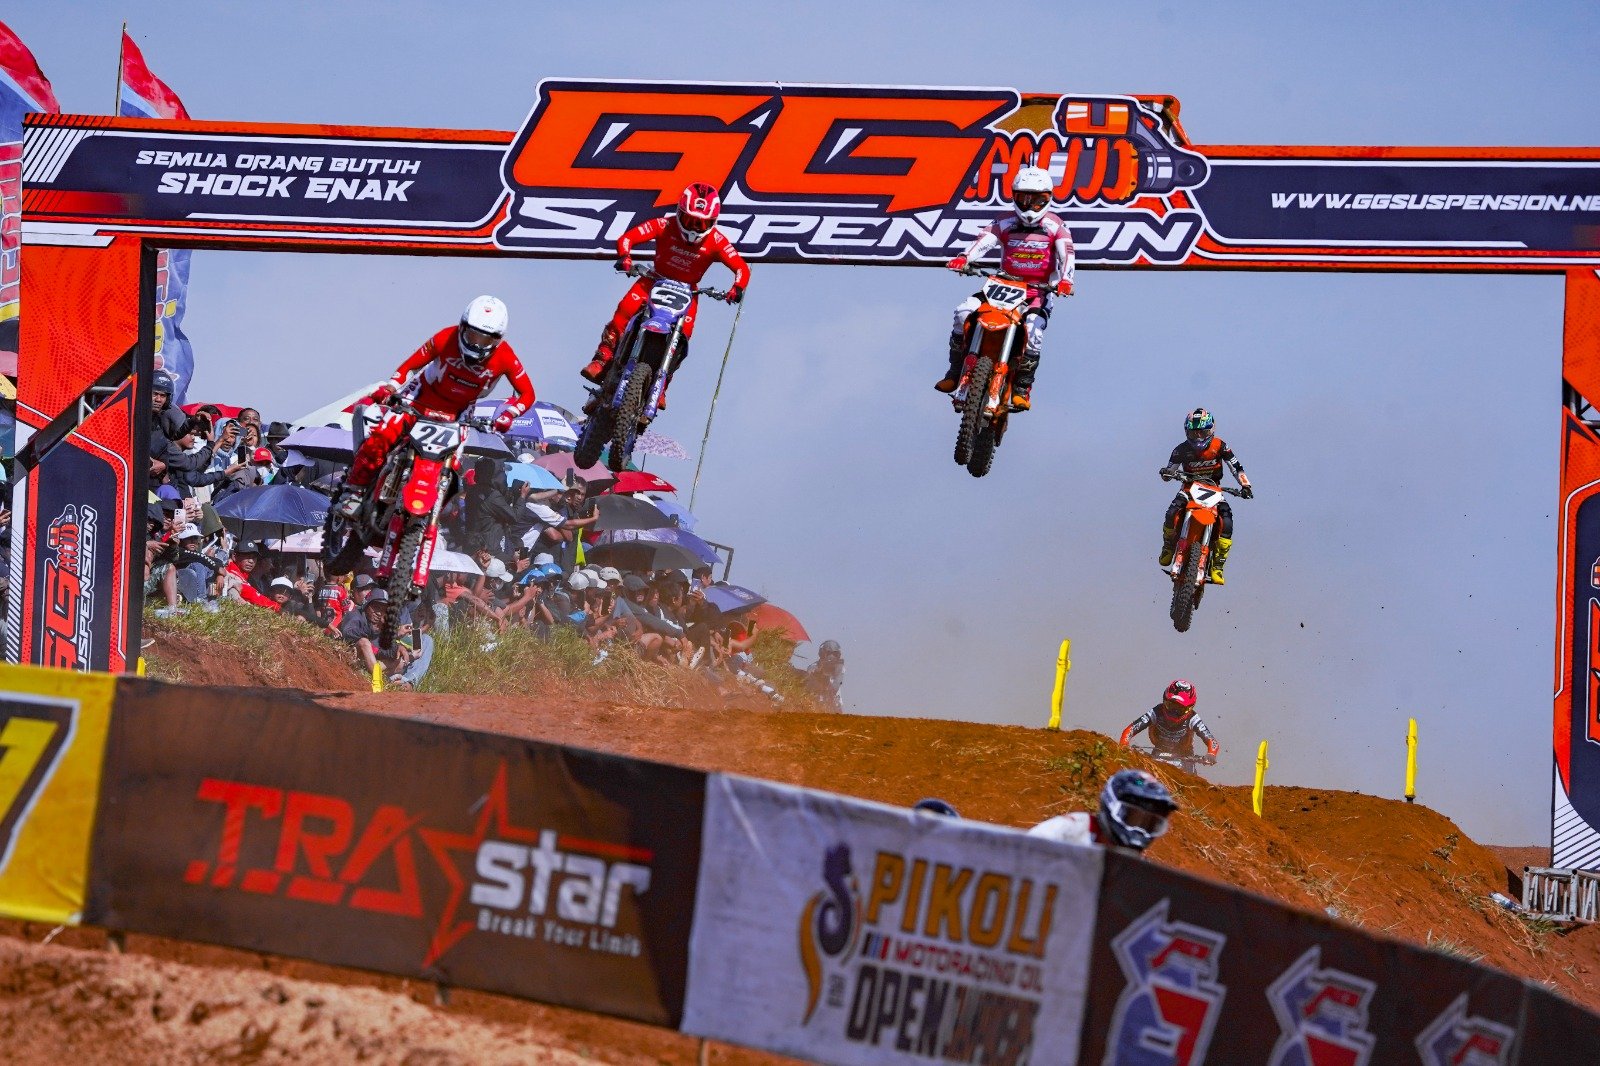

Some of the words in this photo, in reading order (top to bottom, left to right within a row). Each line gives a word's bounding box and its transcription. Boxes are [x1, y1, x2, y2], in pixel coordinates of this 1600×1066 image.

[135, 150, 228, 169] SEMUA
[235, 154, 324, 173] ORANG
[328, 157, 421, 175] BUTUH
[513, 91, 1010, 213] GG
[157, 171, 298, 198] SHOCK
[304, 177, 415, 204] ENAK
[650, 288, 691, 311] 3
[986, 283, 1026, 305] 162
[416, 425, 456, 448] 24
[1196, 487, 1217, 501] 7
[418, 540, 433, 576] DUCATI
[470, 828, 652, 928] star
[477, 908, 537, 939] Break
[543, 919, 586, 947] Your
[588, 930, 642, 958] Limit
[846, 964, 950, 1060] OPEN
